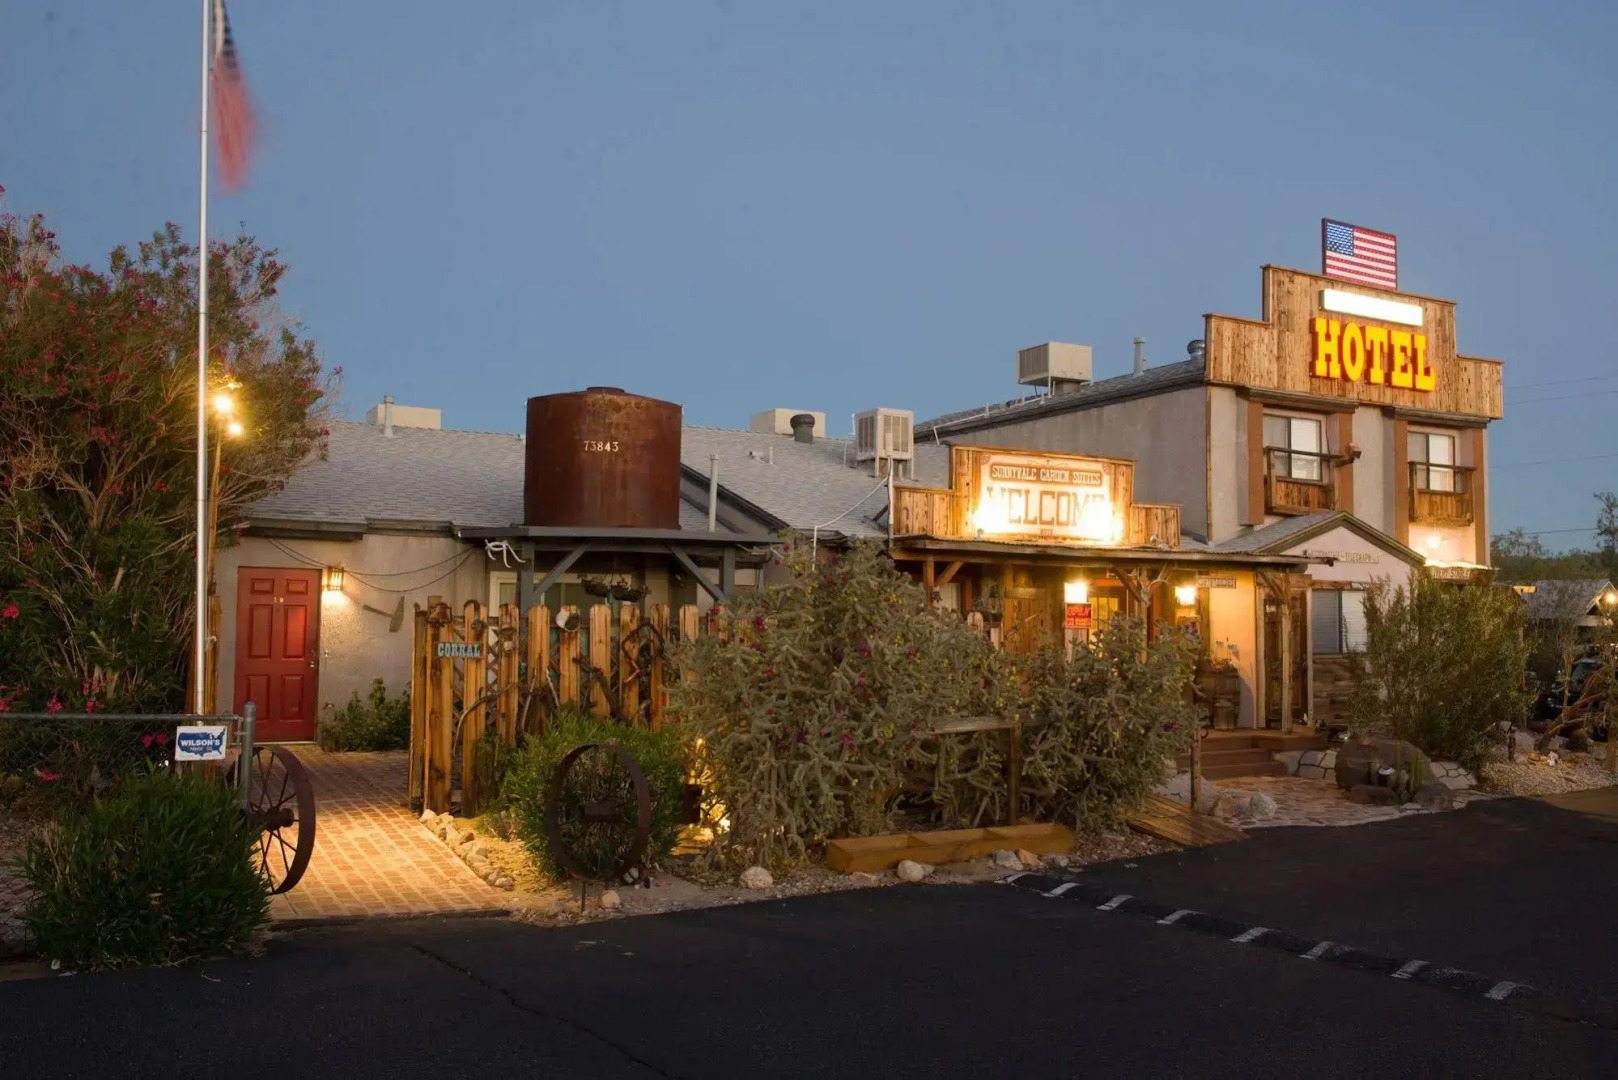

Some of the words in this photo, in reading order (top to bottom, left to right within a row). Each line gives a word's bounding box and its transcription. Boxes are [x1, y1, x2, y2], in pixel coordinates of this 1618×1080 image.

[1309, 316, 1436, 392] HOTEL
[583, 440, 619, 452] 73843
[991, 465, 1037, 481] SUNNYVALE
[1040, 470, 1070, 483] GARDEN
[1072, 471, 1101, 485] SUITES
[986, 485, 1105, 527] ELCOM
[437, 642, 481, 658] CORRAL
